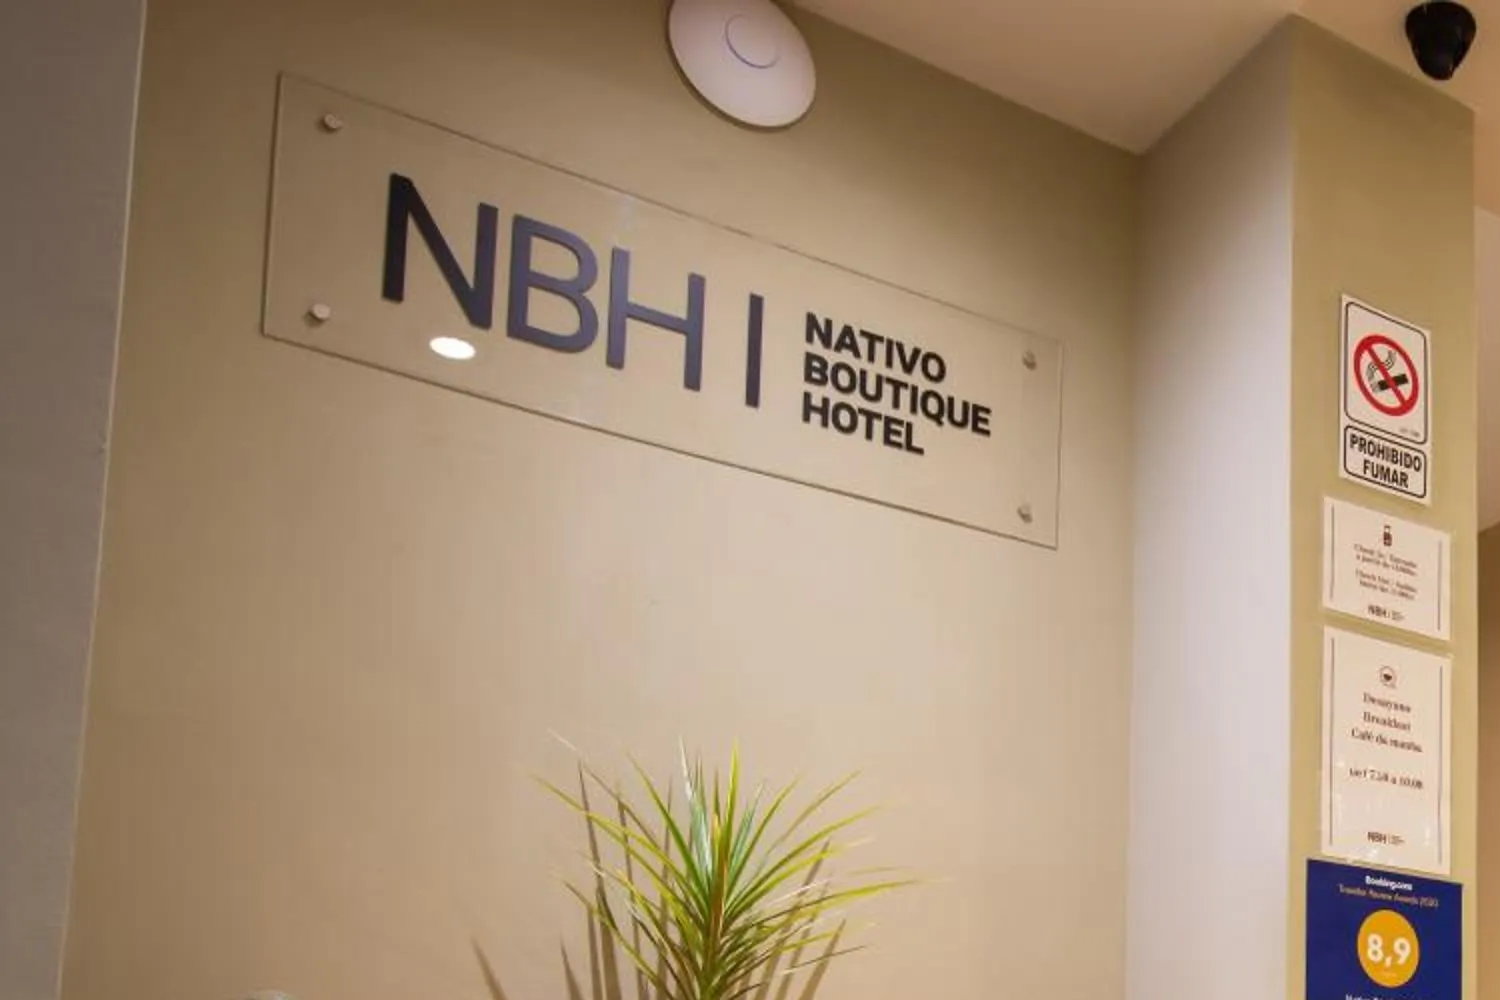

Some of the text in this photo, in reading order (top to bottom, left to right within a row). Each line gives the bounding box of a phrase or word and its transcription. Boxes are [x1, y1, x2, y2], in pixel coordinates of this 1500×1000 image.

[382, 172, 706, 391] NBH
[804, 311, 947, 383] NATIVO
[802, 390, 925, 456] HOTEL
[803, 350, 992, 437] BOUTIQUE
[1349, 432, 1422, 473] PROHIBIDO
[1363, 459, 1409, 489] FUMAR
[1367, 933, 1412, 968] 8,9
